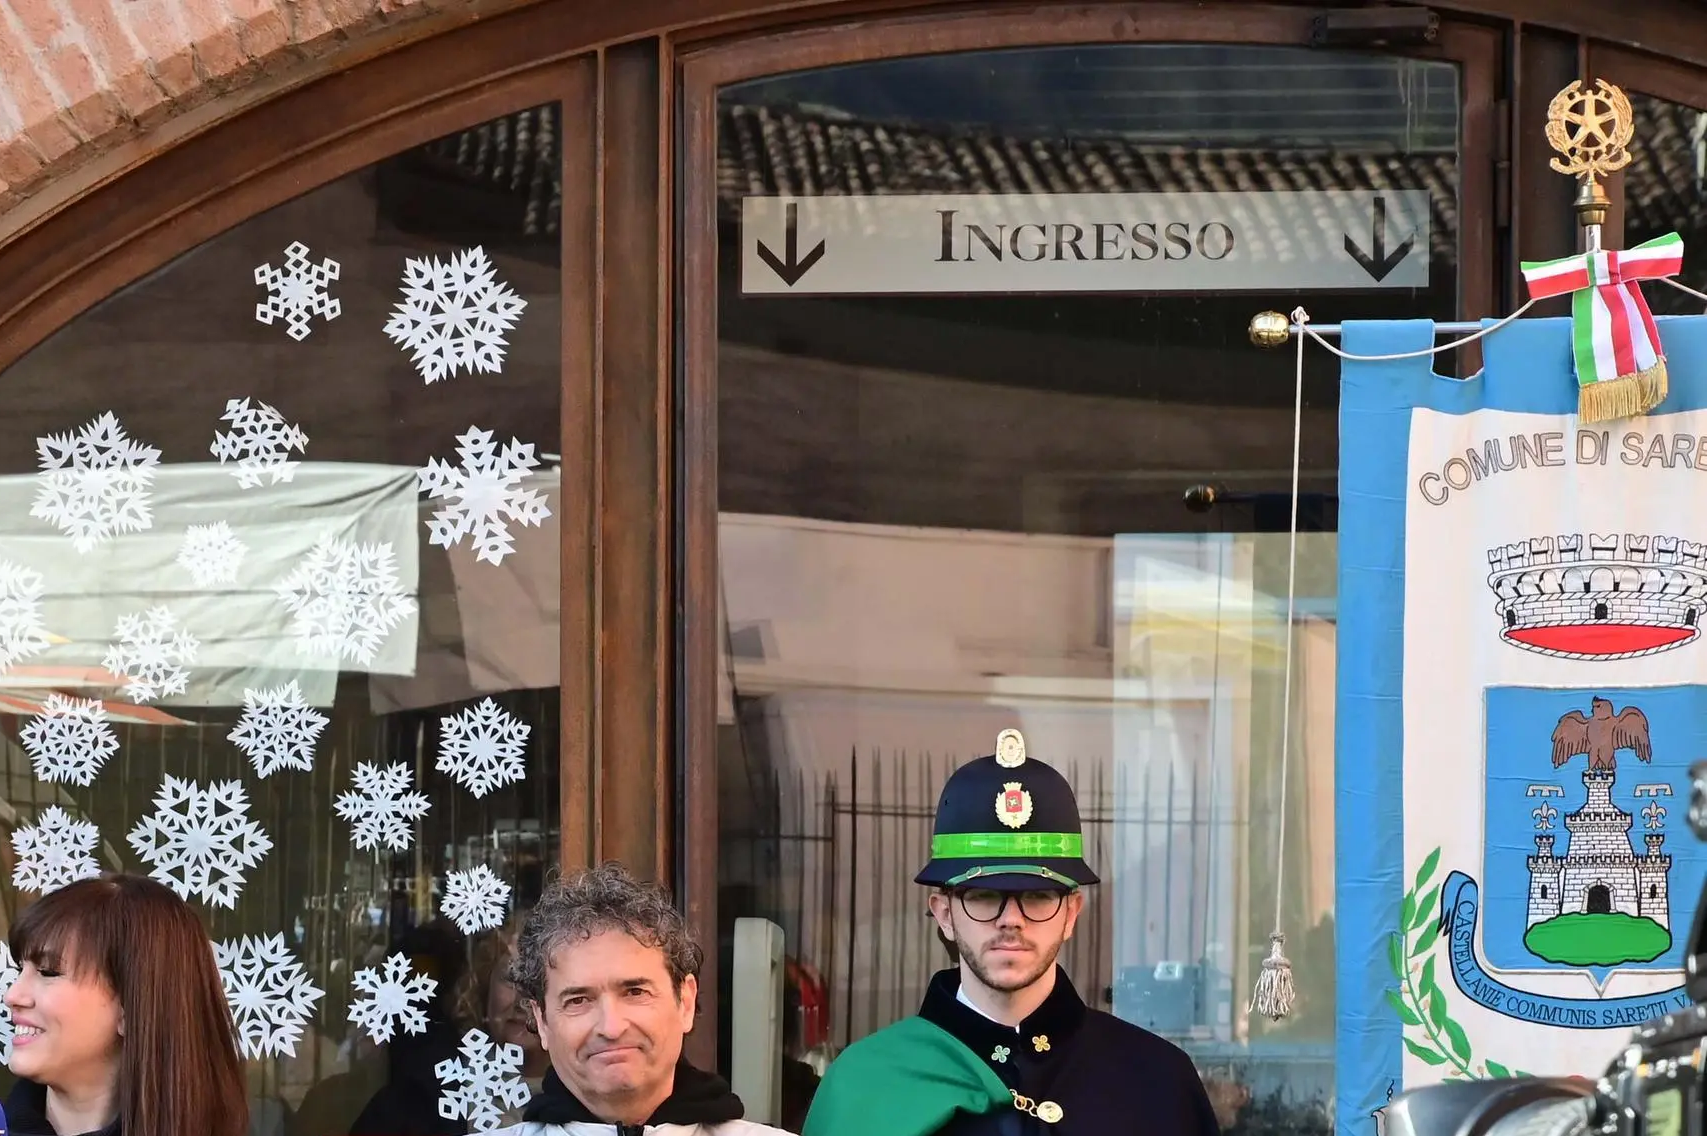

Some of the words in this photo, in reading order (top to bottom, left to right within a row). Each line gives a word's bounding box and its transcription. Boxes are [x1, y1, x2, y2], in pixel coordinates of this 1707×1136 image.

[934, 209, 1235, 262] INGRESSO
[1419, 432, 1566, 505] COMUNE
[1576, 429, 1609, 466] DI
[1454, 900, 1507, 1007] CASTELLANIE
[1506, 994, 1597, 1026] COMMUNIS
